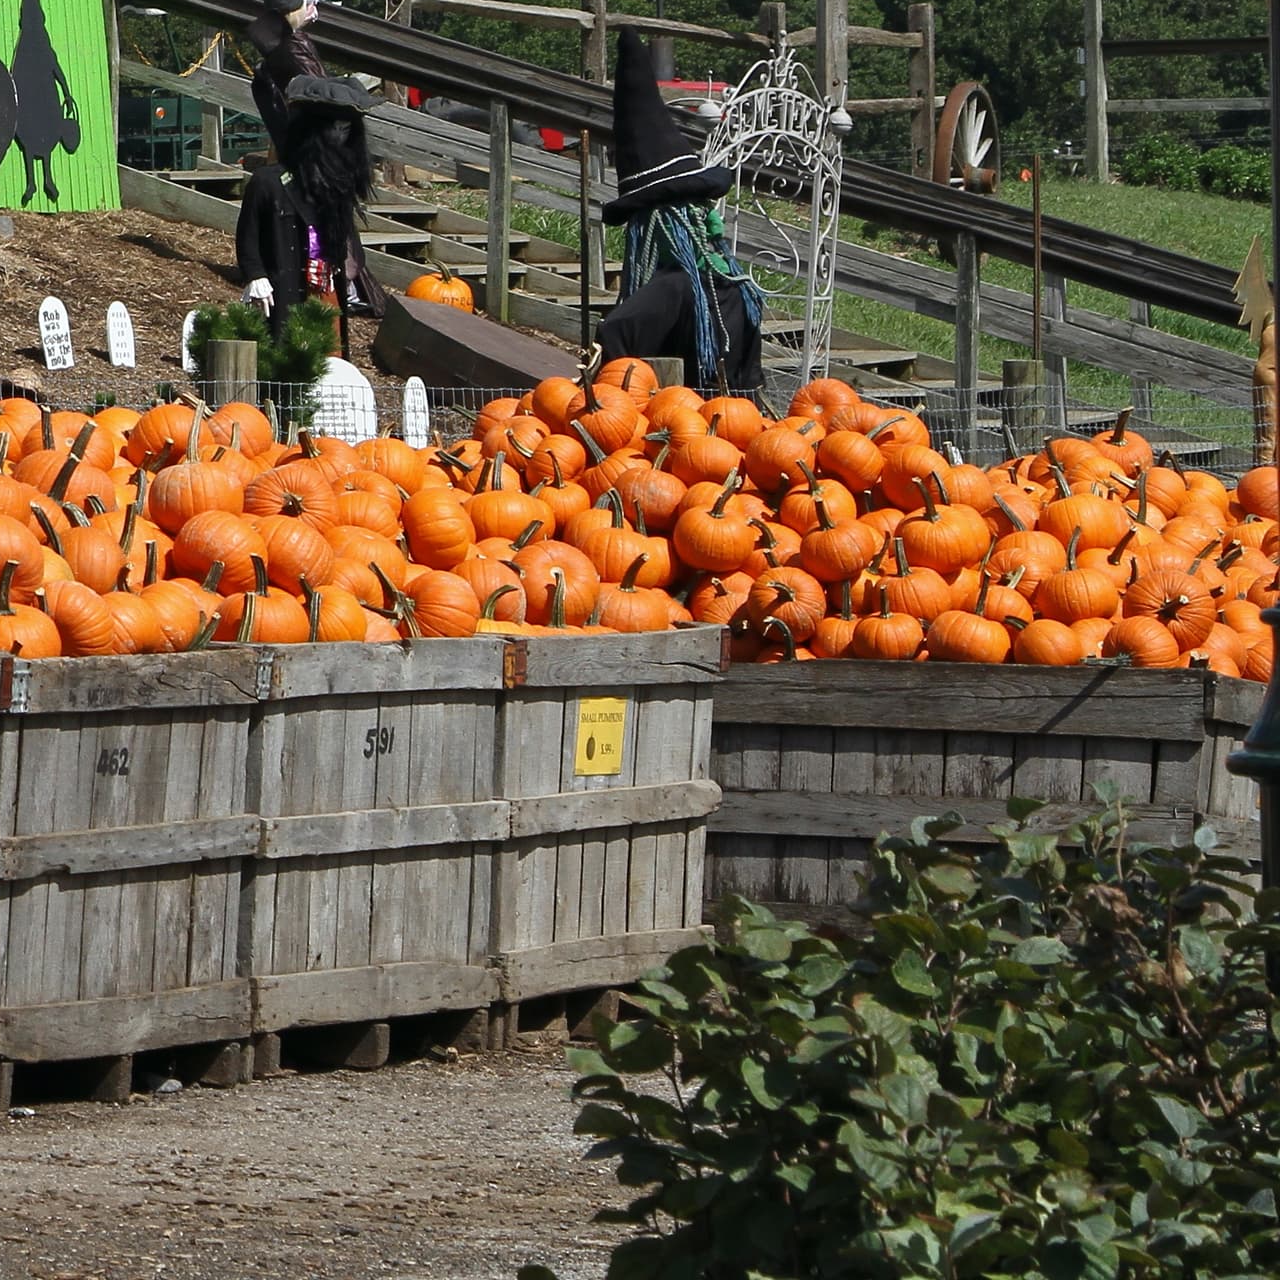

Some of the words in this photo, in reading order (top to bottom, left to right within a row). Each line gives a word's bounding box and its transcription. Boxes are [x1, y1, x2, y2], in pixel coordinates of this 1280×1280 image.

[726, 91, 822, 145] CEMETERY
[43, 310, 60, 322] Rob
[363, 726, 395, 760] 591
[97, 747, 129, 776] 462
